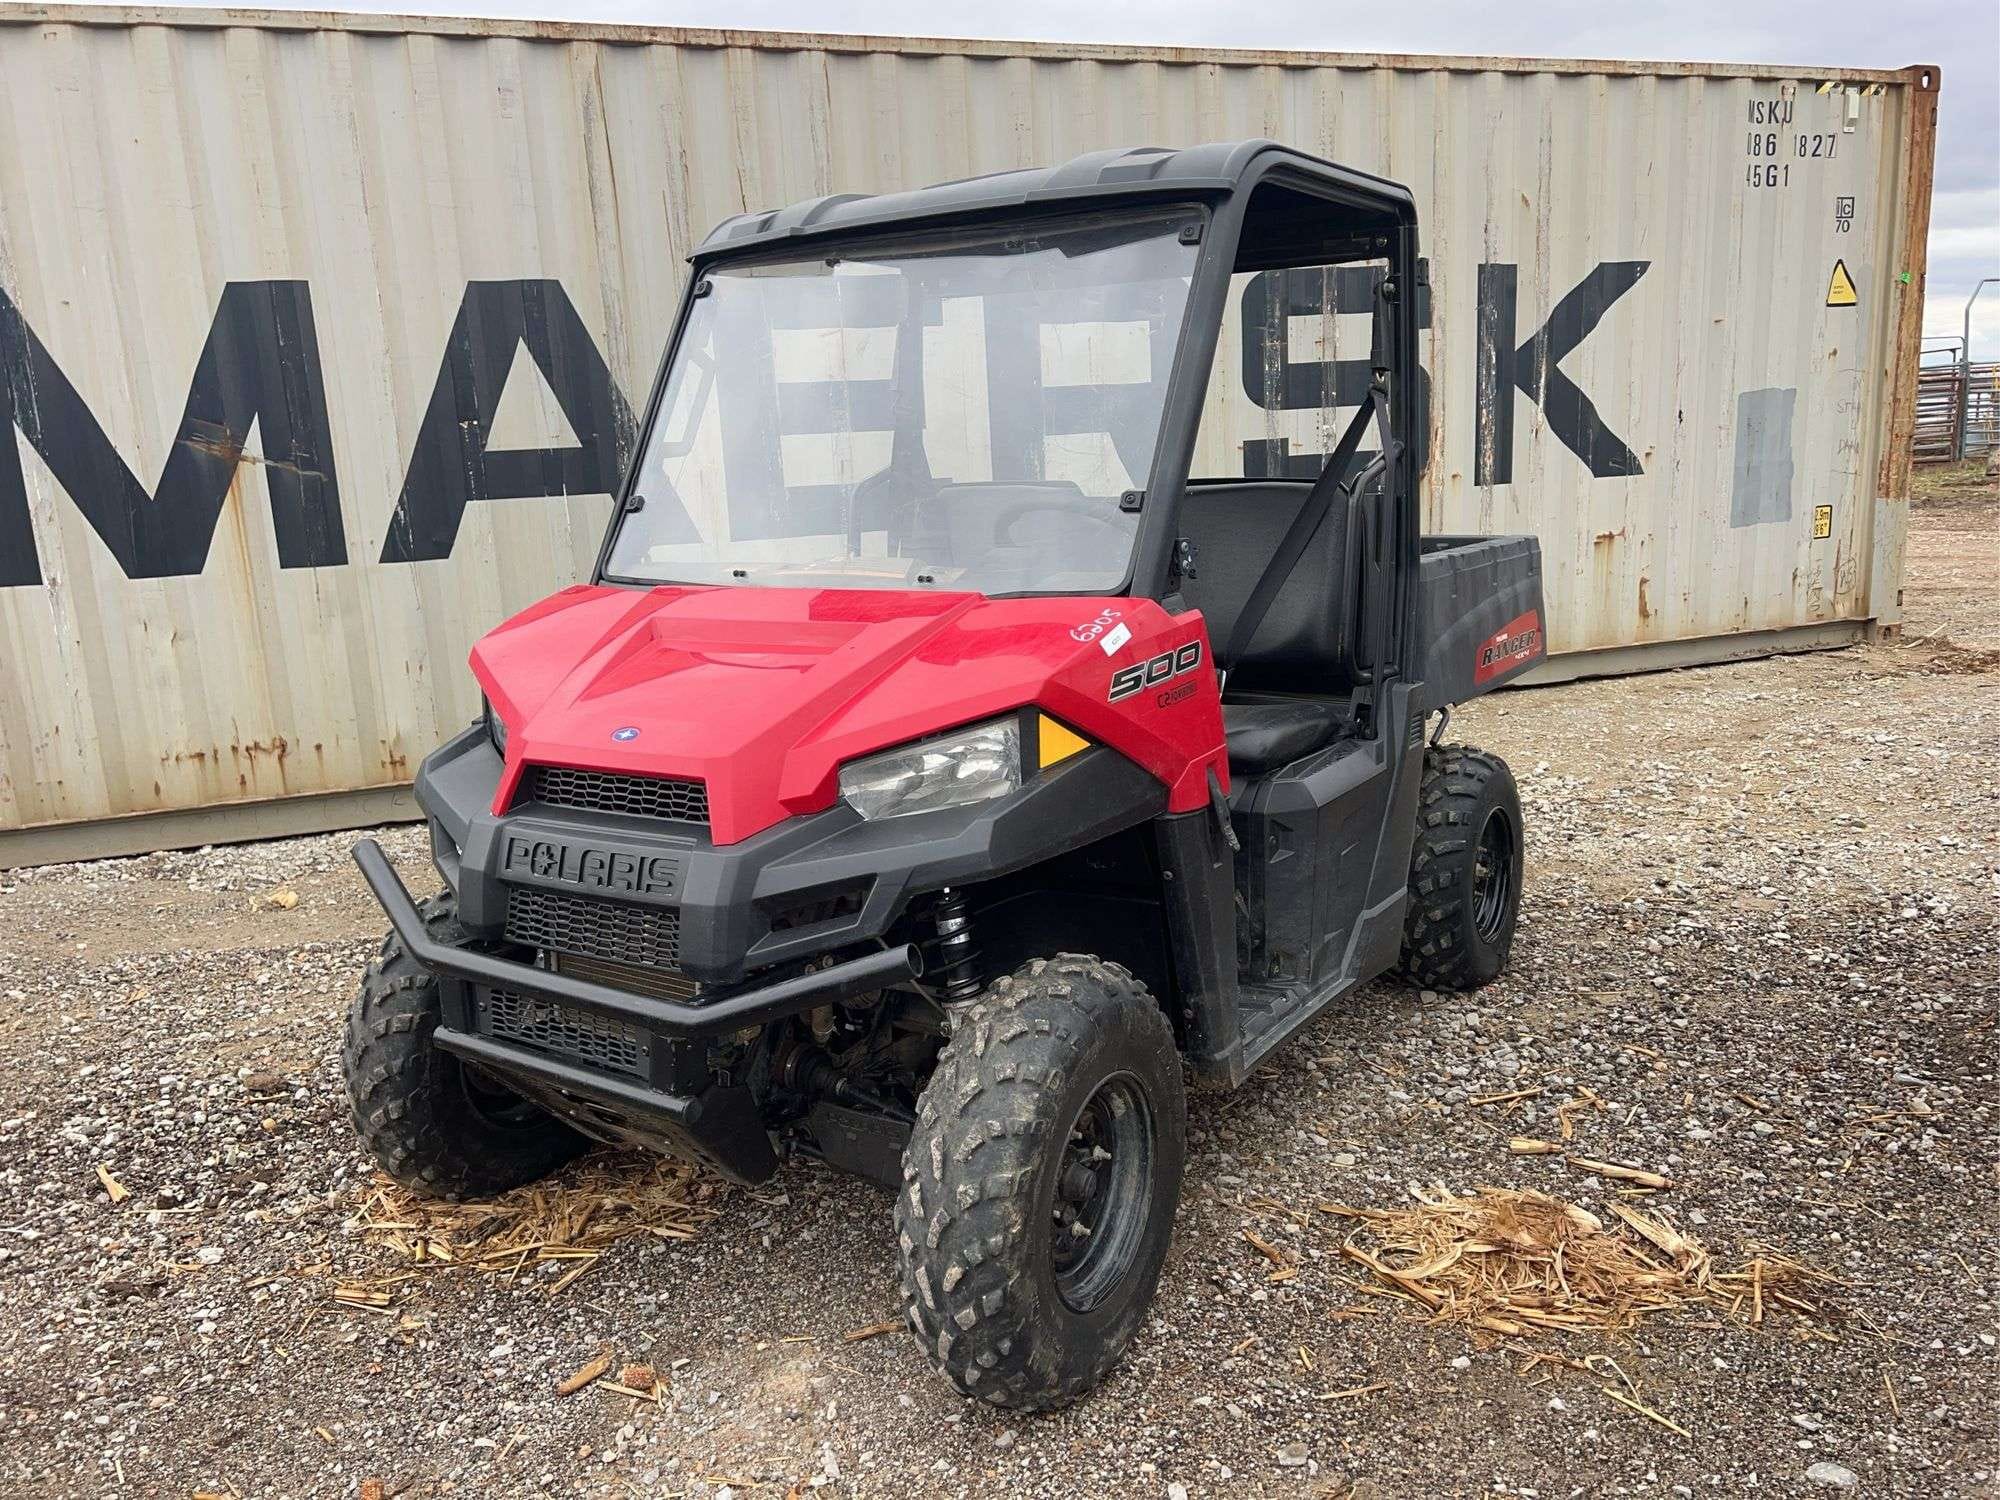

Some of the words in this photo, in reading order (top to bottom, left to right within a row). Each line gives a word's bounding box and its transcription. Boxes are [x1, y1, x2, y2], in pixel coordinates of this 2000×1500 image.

[1746, 163, 1790, 188] 45G1
[1835, 219, 1850, 233] 70
[1480, 629, 1536, 668] RANGER
[1107, 639, 1201, 704] 500
[504, 837, 679, 897] POLARIS
